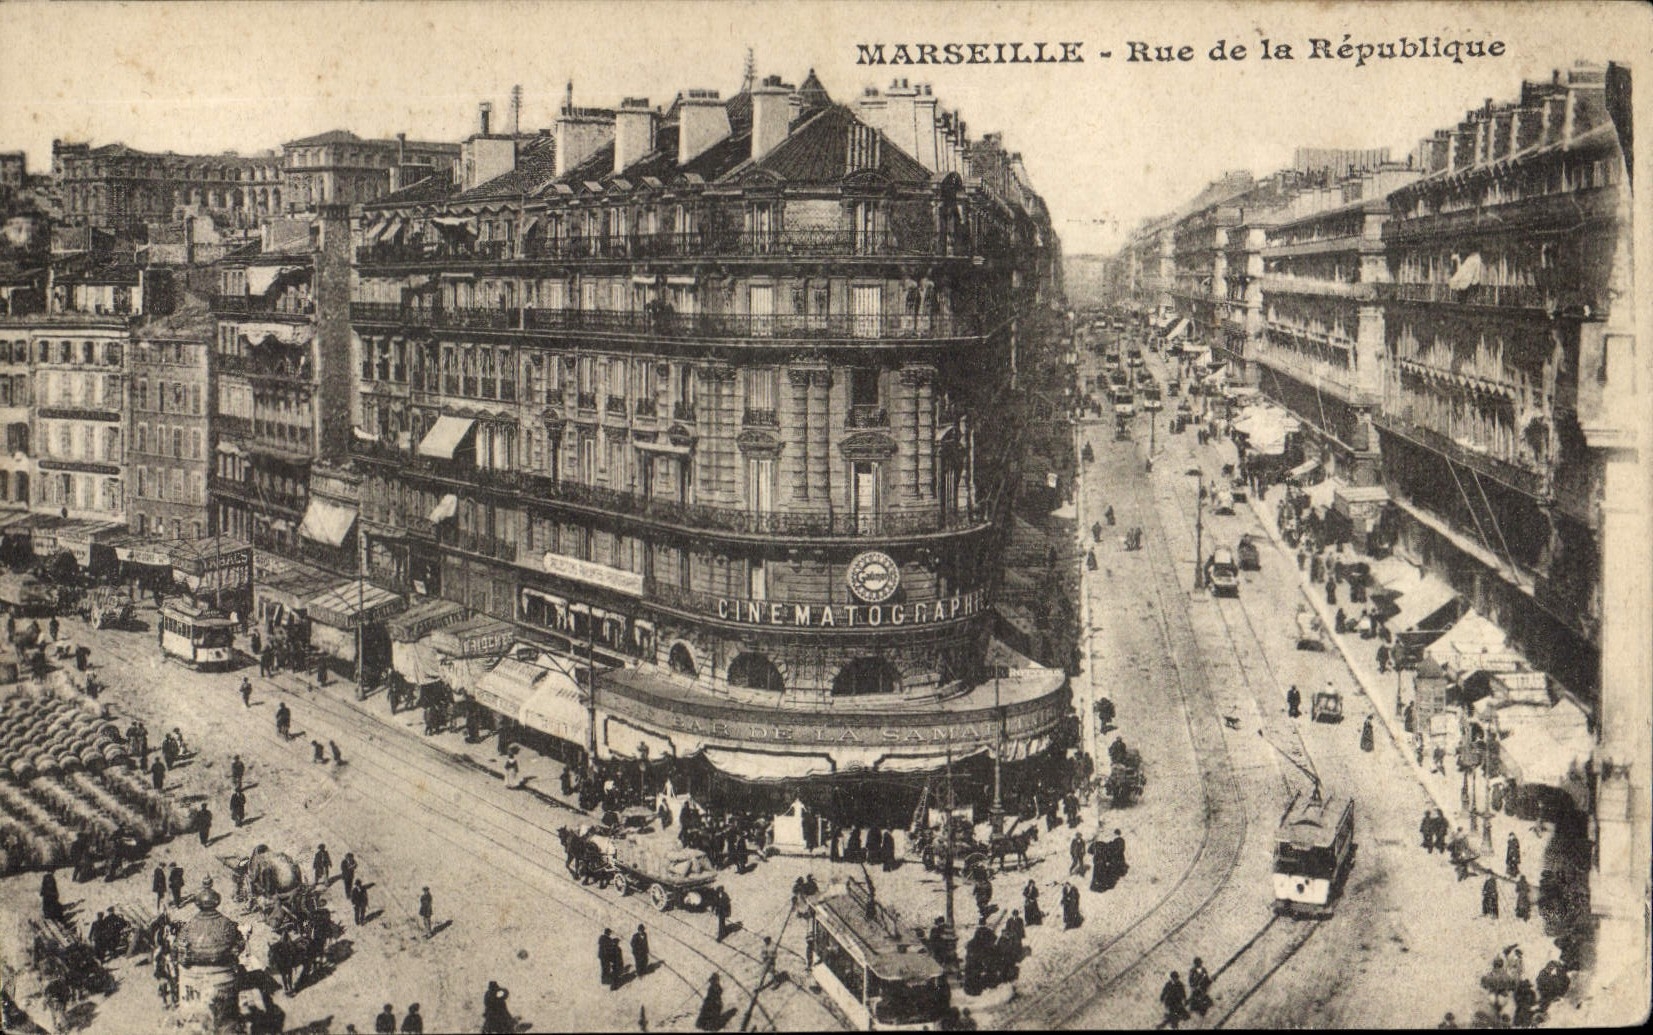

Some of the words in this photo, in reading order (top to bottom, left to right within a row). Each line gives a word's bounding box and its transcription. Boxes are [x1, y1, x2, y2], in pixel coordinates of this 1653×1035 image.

[672, 714, 732, 737] BAR
[750, 725, 793, 741] DE
[814, 727, 865, 743] LA
